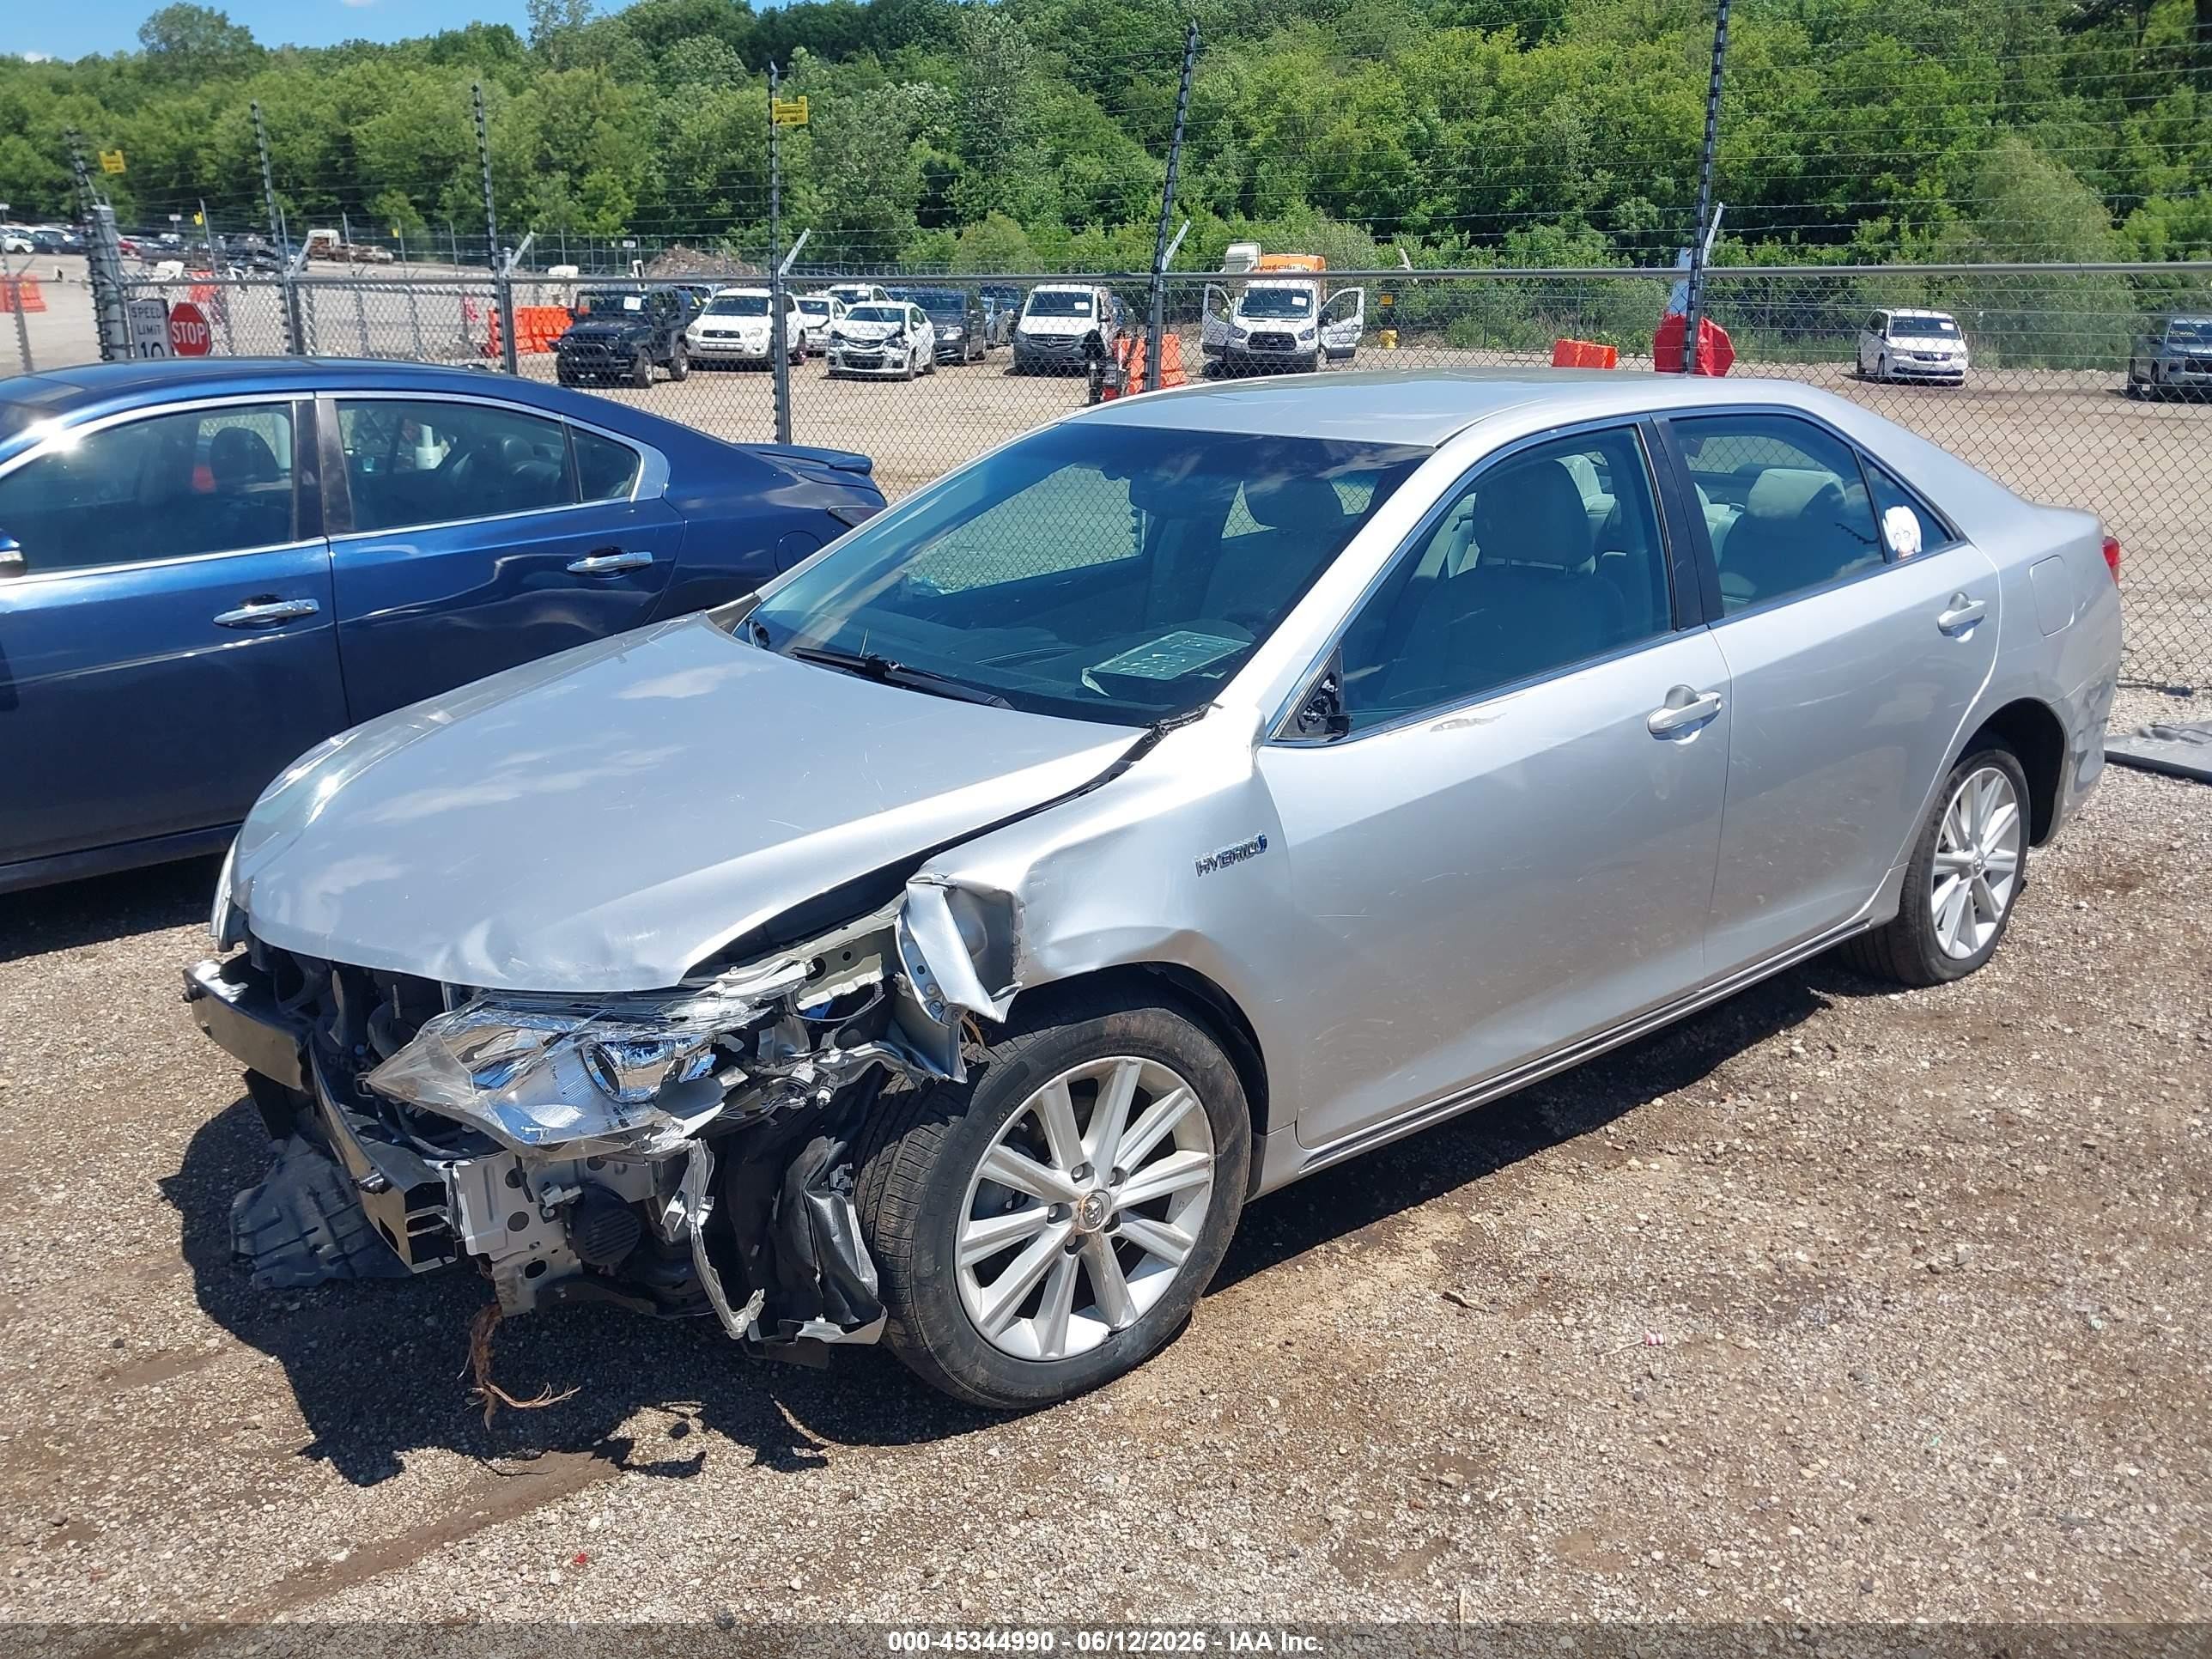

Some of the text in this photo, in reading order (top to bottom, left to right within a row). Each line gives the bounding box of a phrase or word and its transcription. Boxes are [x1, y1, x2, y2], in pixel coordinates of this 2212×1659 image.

[131, 307, 161, 319] SPEED
[137, 324, 161, 335] LIMIT
[172, 321, 206, 344] STOP
[1196, 841, 1261, 877] HYBRID
